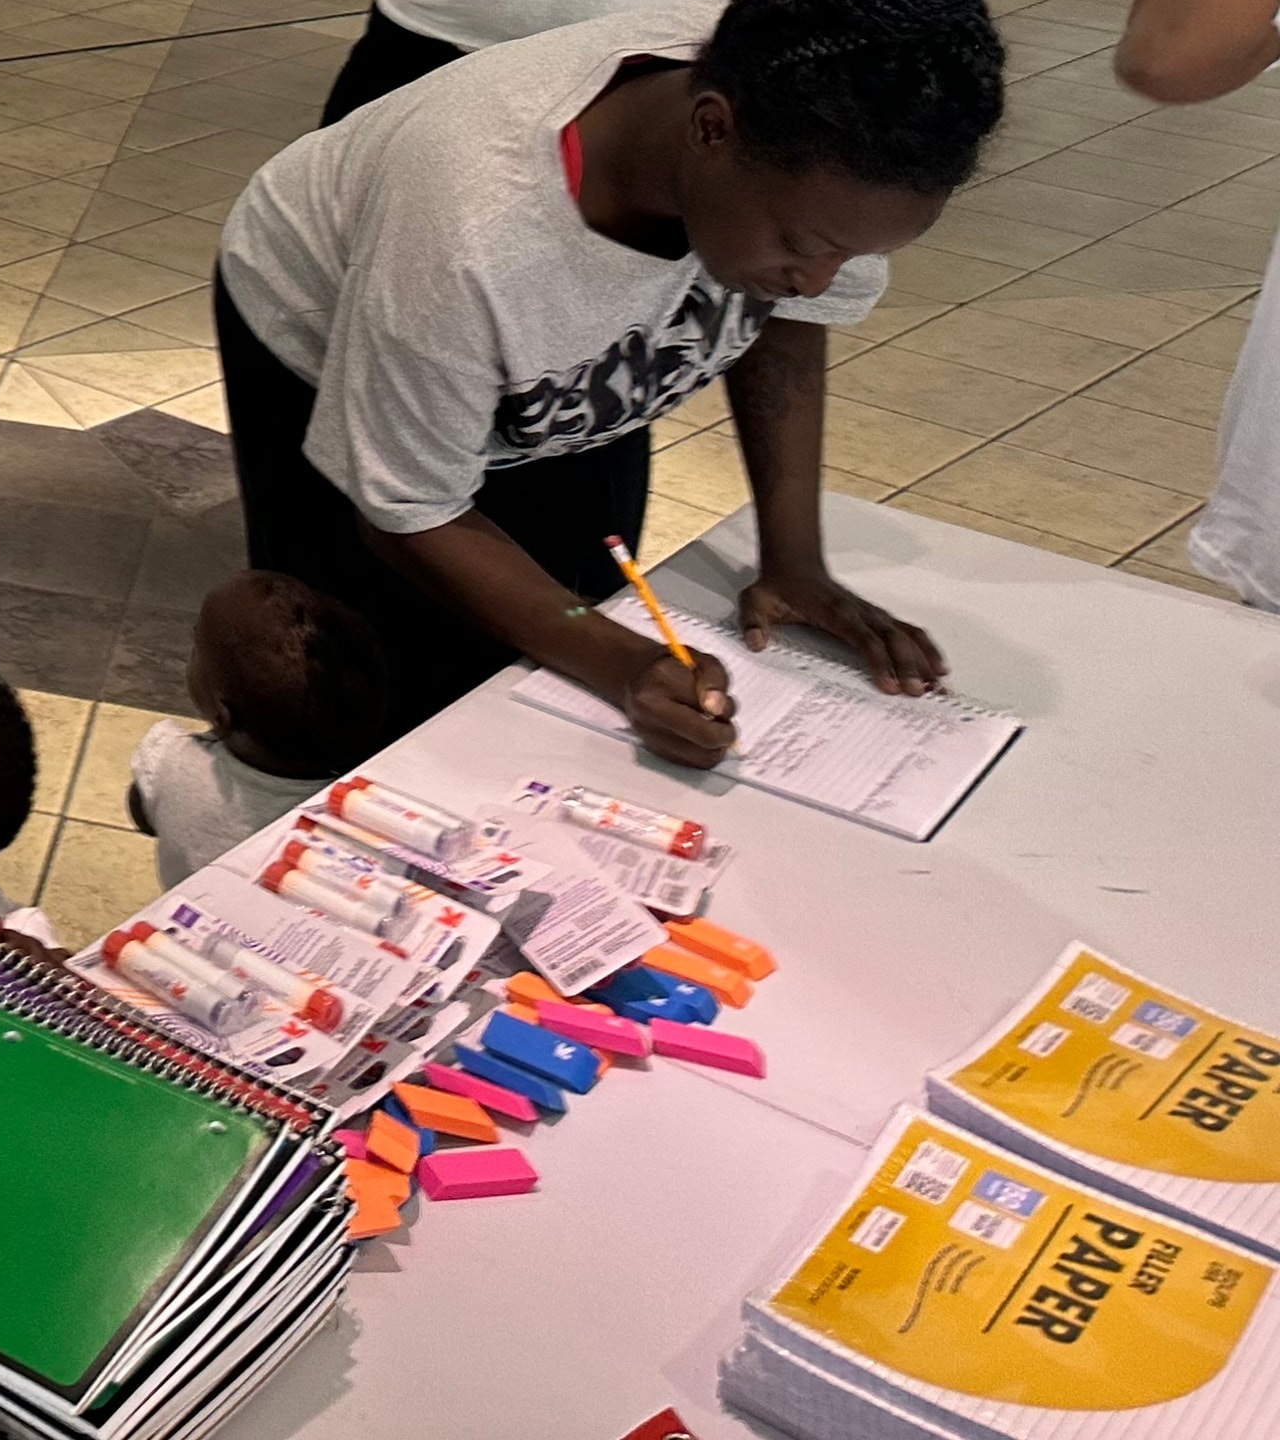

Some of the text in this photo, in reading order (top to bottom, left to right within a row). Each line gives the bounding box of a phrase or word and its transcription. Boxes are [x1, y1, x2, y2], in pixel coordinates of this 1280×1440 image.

[1168, 1037, 1280, 1133] PAPER
[1014, 1212, 1144, 1345] PAPER
[1128, 1238, 1183, 1296] FILLER
